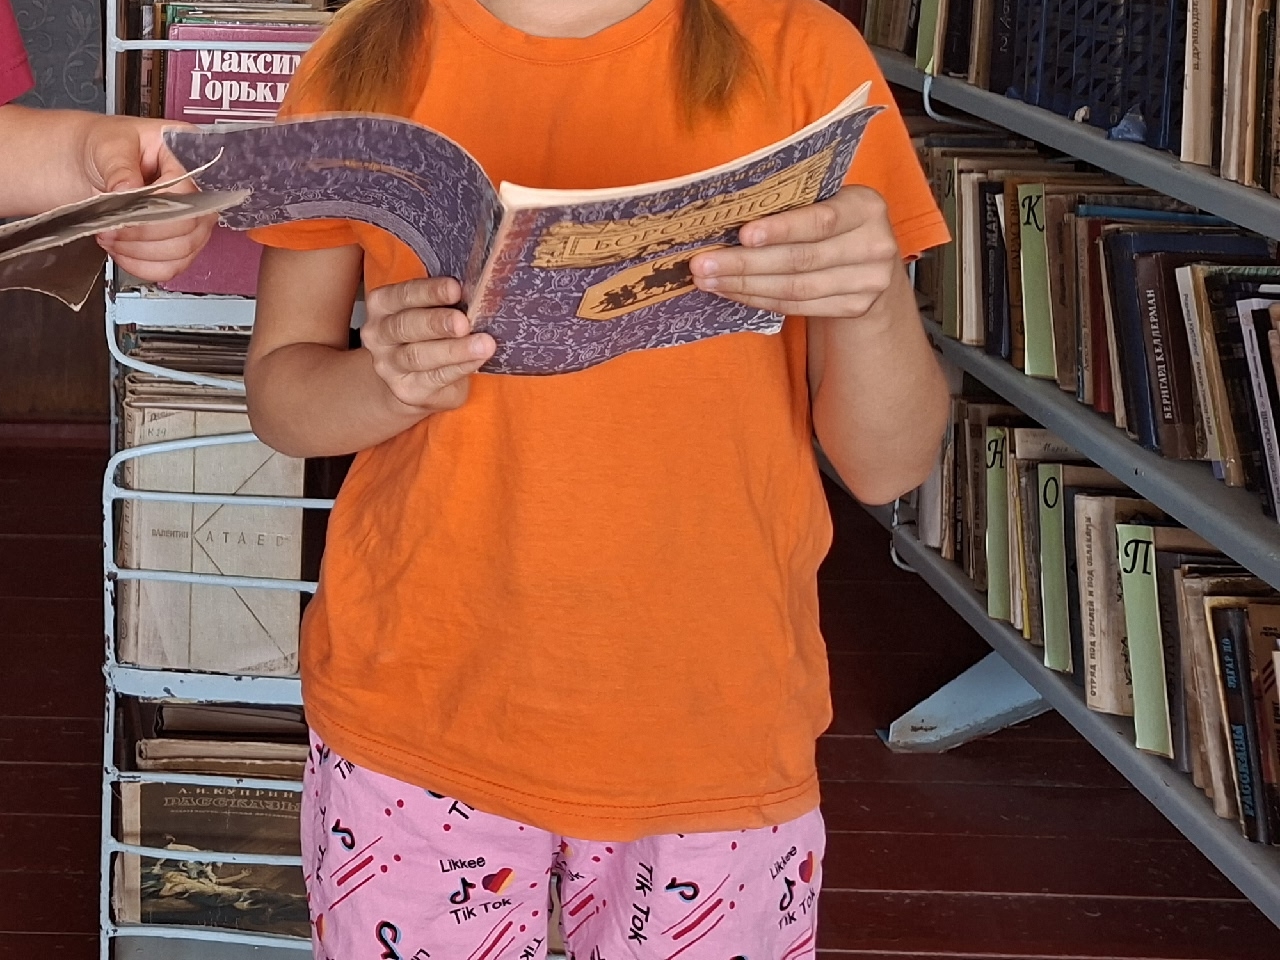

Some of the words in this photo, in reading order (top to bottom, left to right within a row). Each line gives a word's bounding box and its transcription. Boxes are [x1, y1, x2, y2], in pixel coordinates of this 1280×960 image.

[594, 191, 782, 251] БОРОДИНО
[1021, 194, 1045, 232] К
[1145, 288, 1166, 362] КЕЛЛЕРМАН
[1155, 363, 1174, 421] БЕРНГАРД
[1122, 537, 1153, 577] П
[1087, 599, 1096, 637] ЗЕМЛЕЙ
[1088, 640, 1096, 660] ПОД
[1089, 664, 1097, 697] ОТРЯД
[213, 787, 294, 799] КУПРИН
[439, 856, 487, 874] Likkee
[635, 862, 654, 898] Tik
[449, 906, 478, 925] Tik
[478, 897, 512, 914] Tok
[627, 902, 651, 946] Tok
